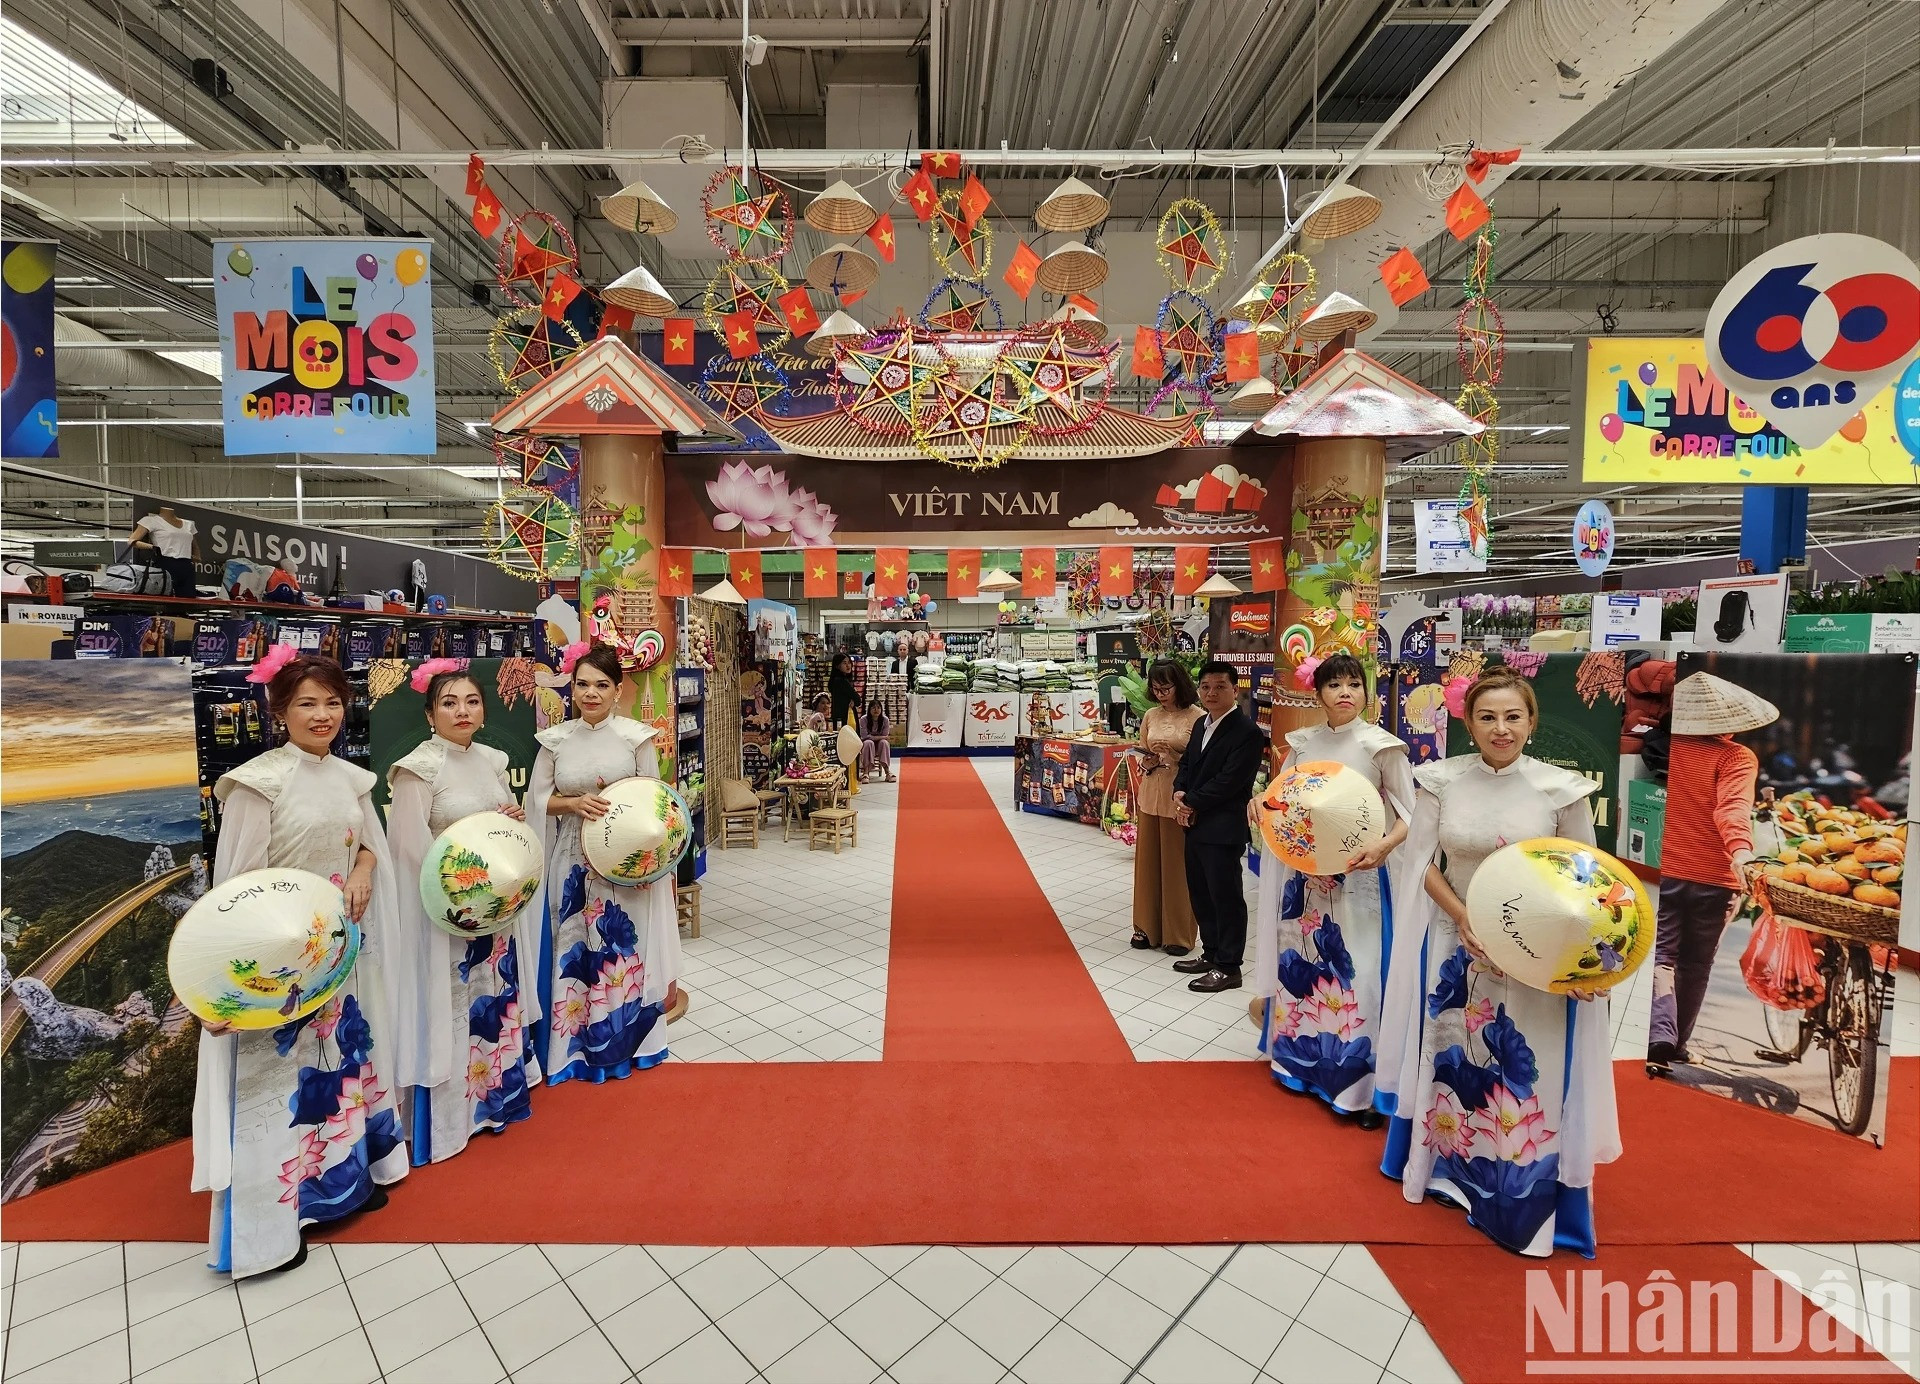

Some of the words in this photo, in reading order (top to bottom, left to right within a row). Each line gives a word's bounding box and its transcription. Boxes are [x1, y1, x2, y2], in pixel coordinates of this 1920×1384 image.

[291, 265, 358, 322] LE
[1718, 263, 1920, 379] 60
[233, 310, 419, 390] MOIS
[299, 335, 339, 363] 60
[770, 352, 808, 371] Fête
[811, 357, 832, 370] de
[305, 363, 331, 373] ans
[241, 391, 410, 421] CARREFOUR
[1617, 380, 1672, 427] LE
[1771, 381, 1857, 410] ans
[888, 485, 971, 517] VIÊT
[980, 491, 1060, 516] NAM
[211, 524, 328, 568] SAISON
[1579, 524, 1610, 551] MOIS
[82, 622, 109, 631] DIM
[200, 625, 220, 633] DIM
[1231, 610, 1269, 622] Cholimex
[81, 635, 120, 651] 50%
[197, 637, 226, 652] 50%
[350, 640, 372, 652] 50%
[1213, 653, 1244, 662] RETROUVER
[1245, 653, 1255, 662] LES
[1503, 927, 1544, 960] Nam
